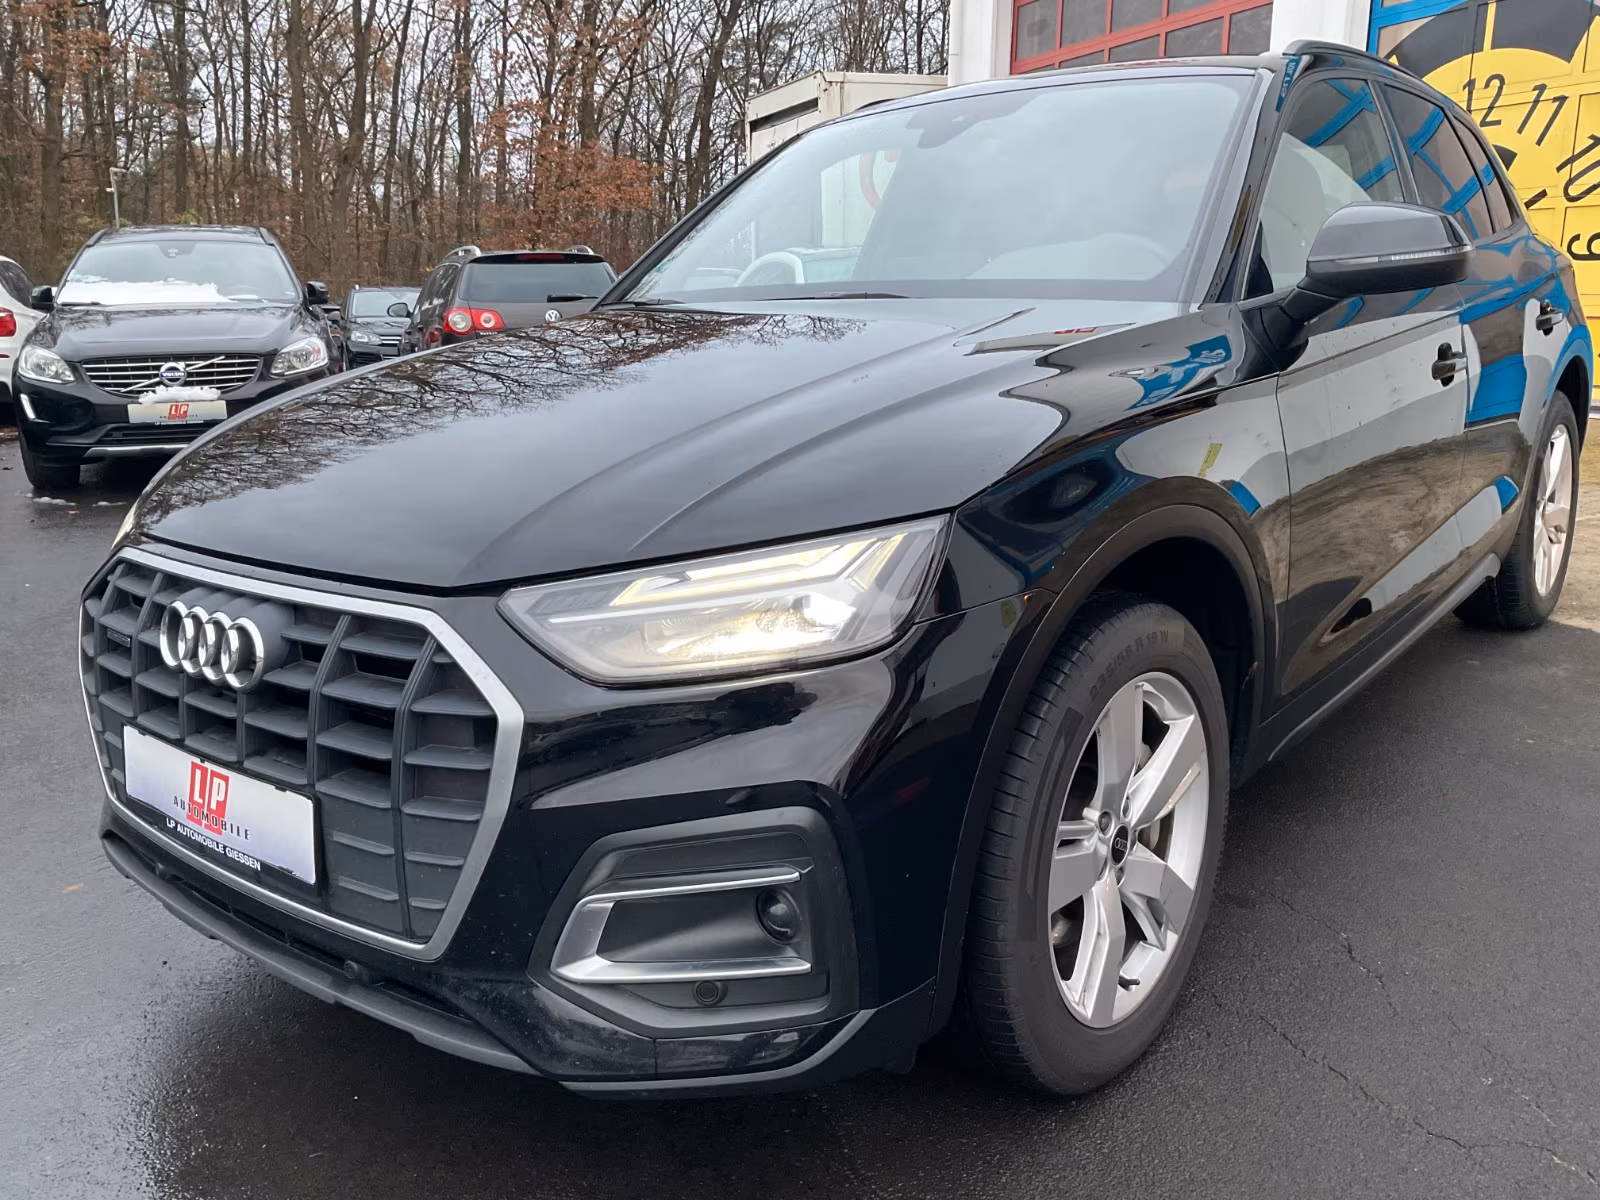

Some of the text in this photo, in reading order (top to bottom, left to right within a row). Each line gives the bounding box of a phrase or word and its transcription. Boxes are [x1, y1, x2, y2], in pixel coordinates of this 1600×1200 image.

[1462, 73, 1506, 128] 12
[1516, 82, 1569, 147] 11
[1556, 134, 1600, 203] 10
[171, 404, 189, 415] LP
[193, 768, 227, 811] LP
[166, 817, 261, 871] LP AUTOMOBILE GIESSEN
[173, 795, 250, 841] AUTOMOBILE
